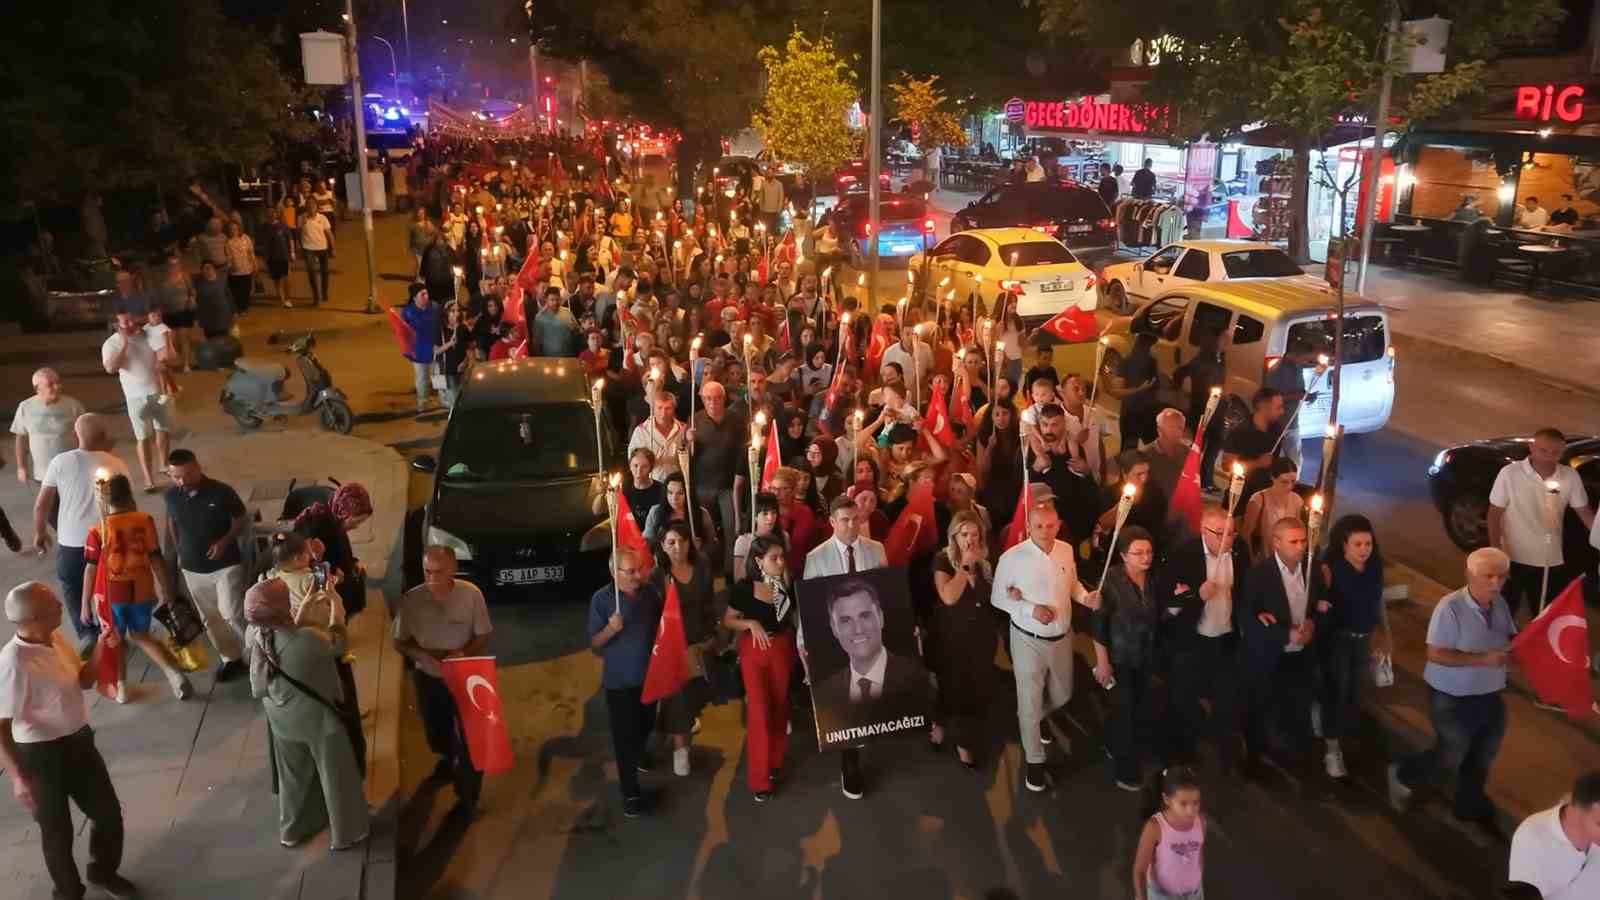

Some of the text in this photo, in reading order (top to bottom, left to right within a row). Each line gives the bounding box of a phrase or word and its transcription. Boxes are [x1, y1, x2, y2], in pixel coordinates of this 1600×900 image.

[1025, 101, 1063, 128] GECE
[502, 570, 514, 581] 35
[520, 568, 538, 580] AAP
